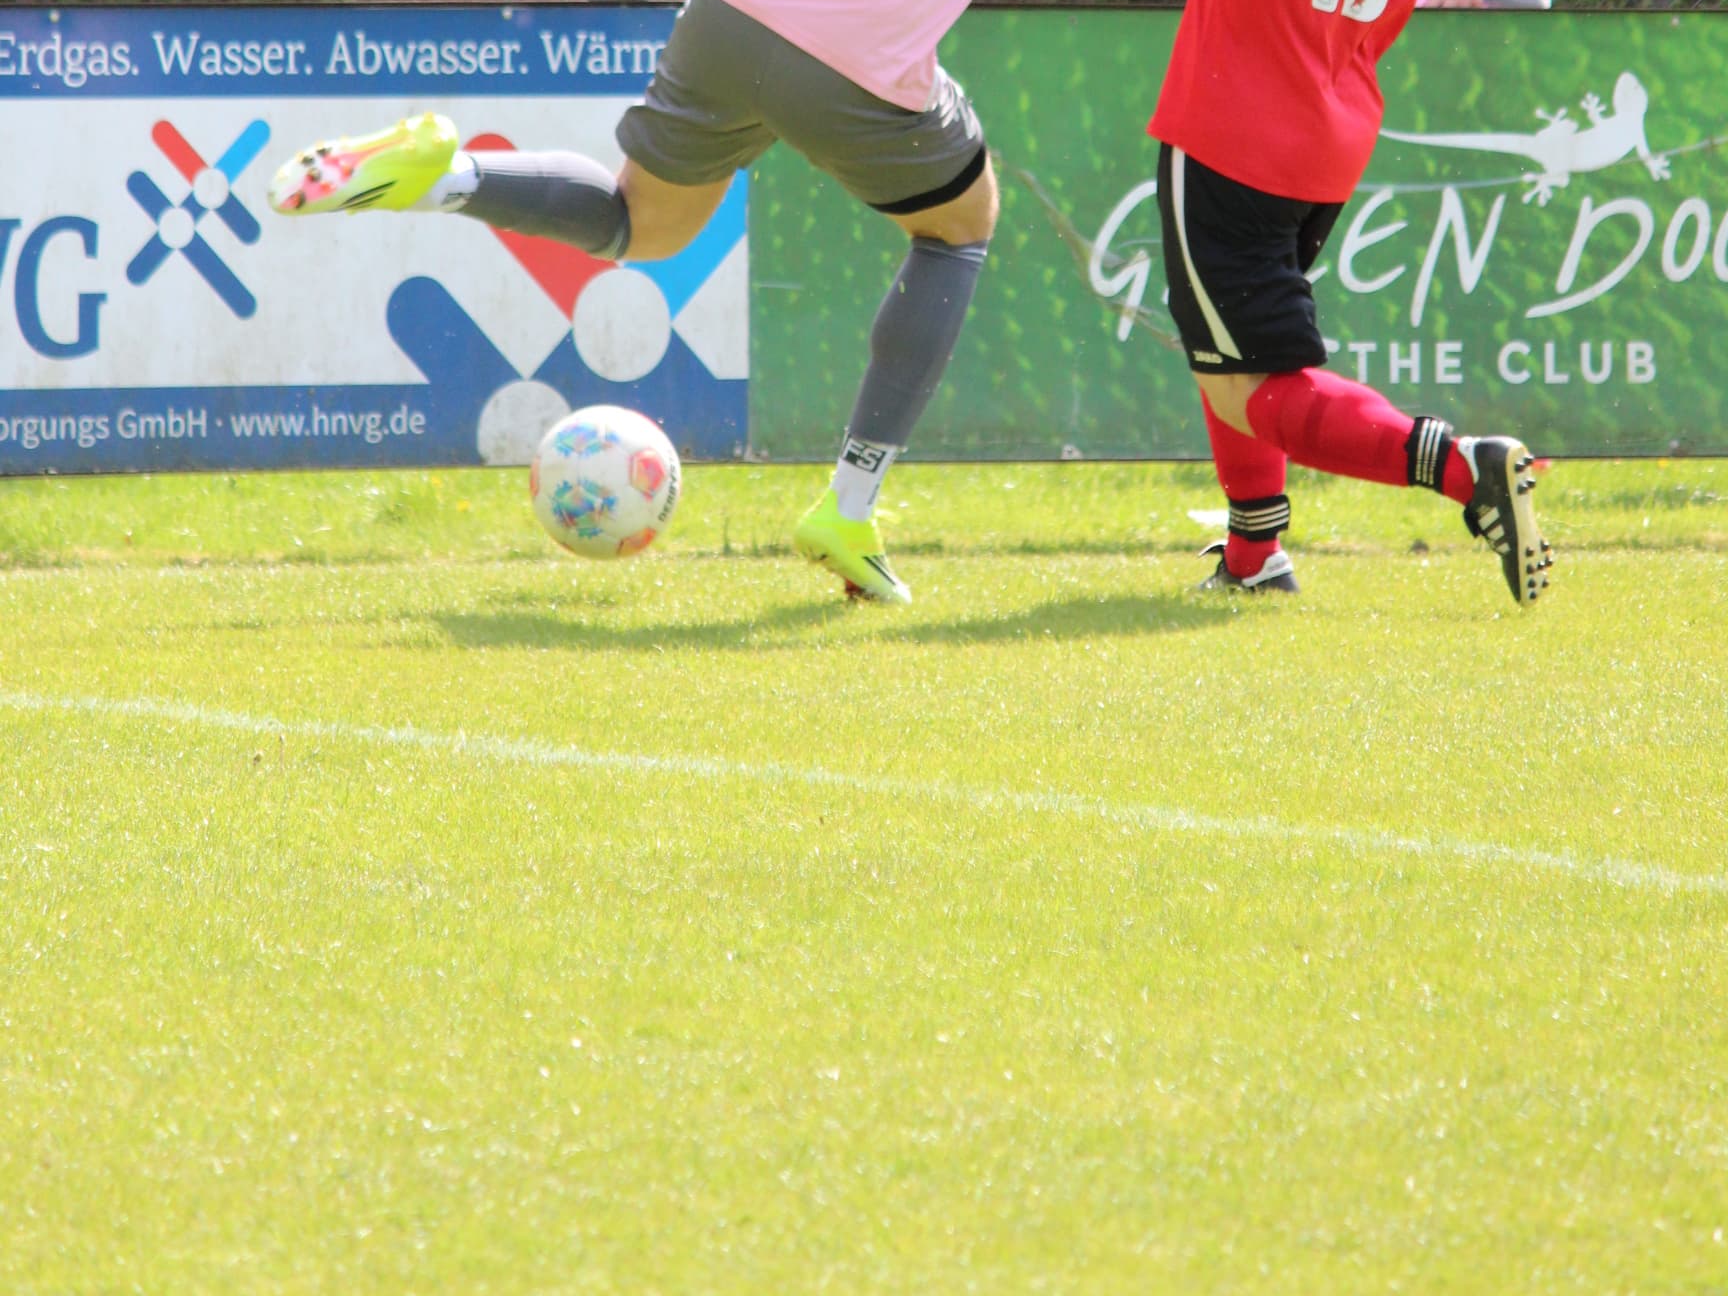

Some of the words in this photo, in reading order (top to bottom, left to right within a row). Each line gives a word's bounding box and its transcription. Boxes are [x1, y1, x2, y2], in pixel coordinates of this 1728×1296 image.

[0, 31, 139, 88] Erdgas.
[153, 31, 312, 75] Wasser.
[326, 31, 528, 75] Abwasser.
[1089, 179, 1505, 342] GEN
[1498, 341, 1657, 385] CLUB
[117, 406, 207, 439] GmbH
[230, 403, 426, 444] www.hnvg.de
